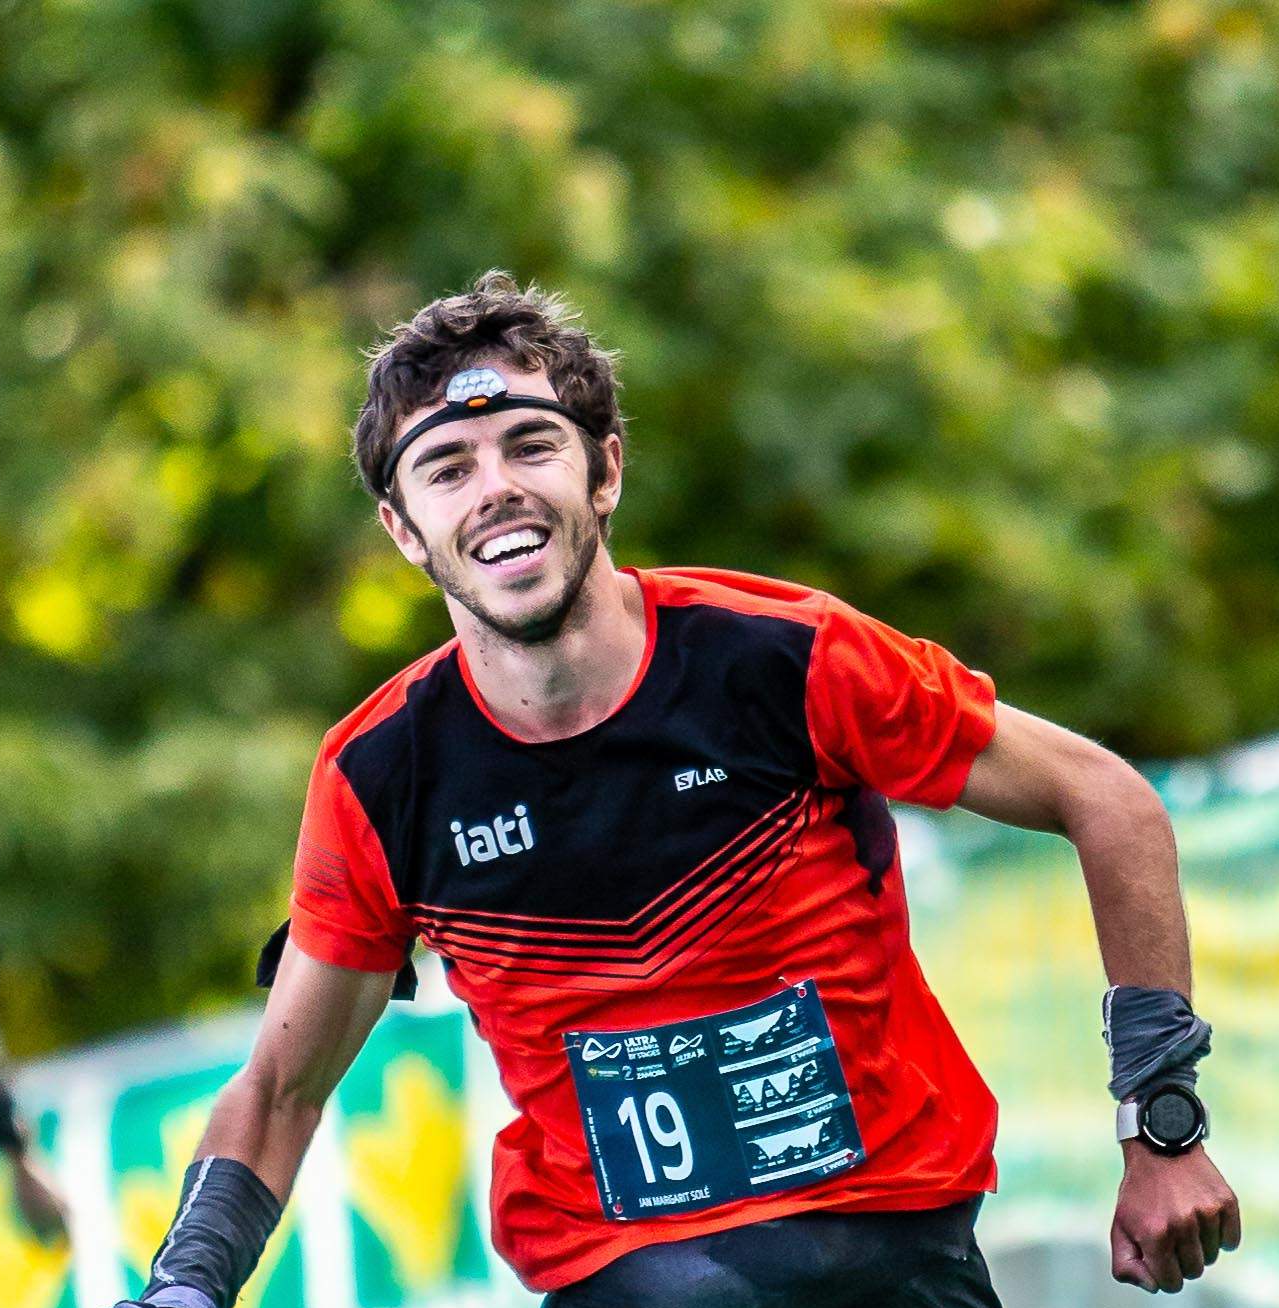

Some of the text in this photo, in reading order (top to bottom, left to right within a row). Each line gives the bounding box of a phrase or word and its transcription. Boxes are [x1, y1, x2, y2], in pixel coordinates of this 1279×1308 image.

[450, 804, 534, 867] iati
[623, 1034, 657, 1047] ULTRA
[617, 1091, 694, 1184] 19
